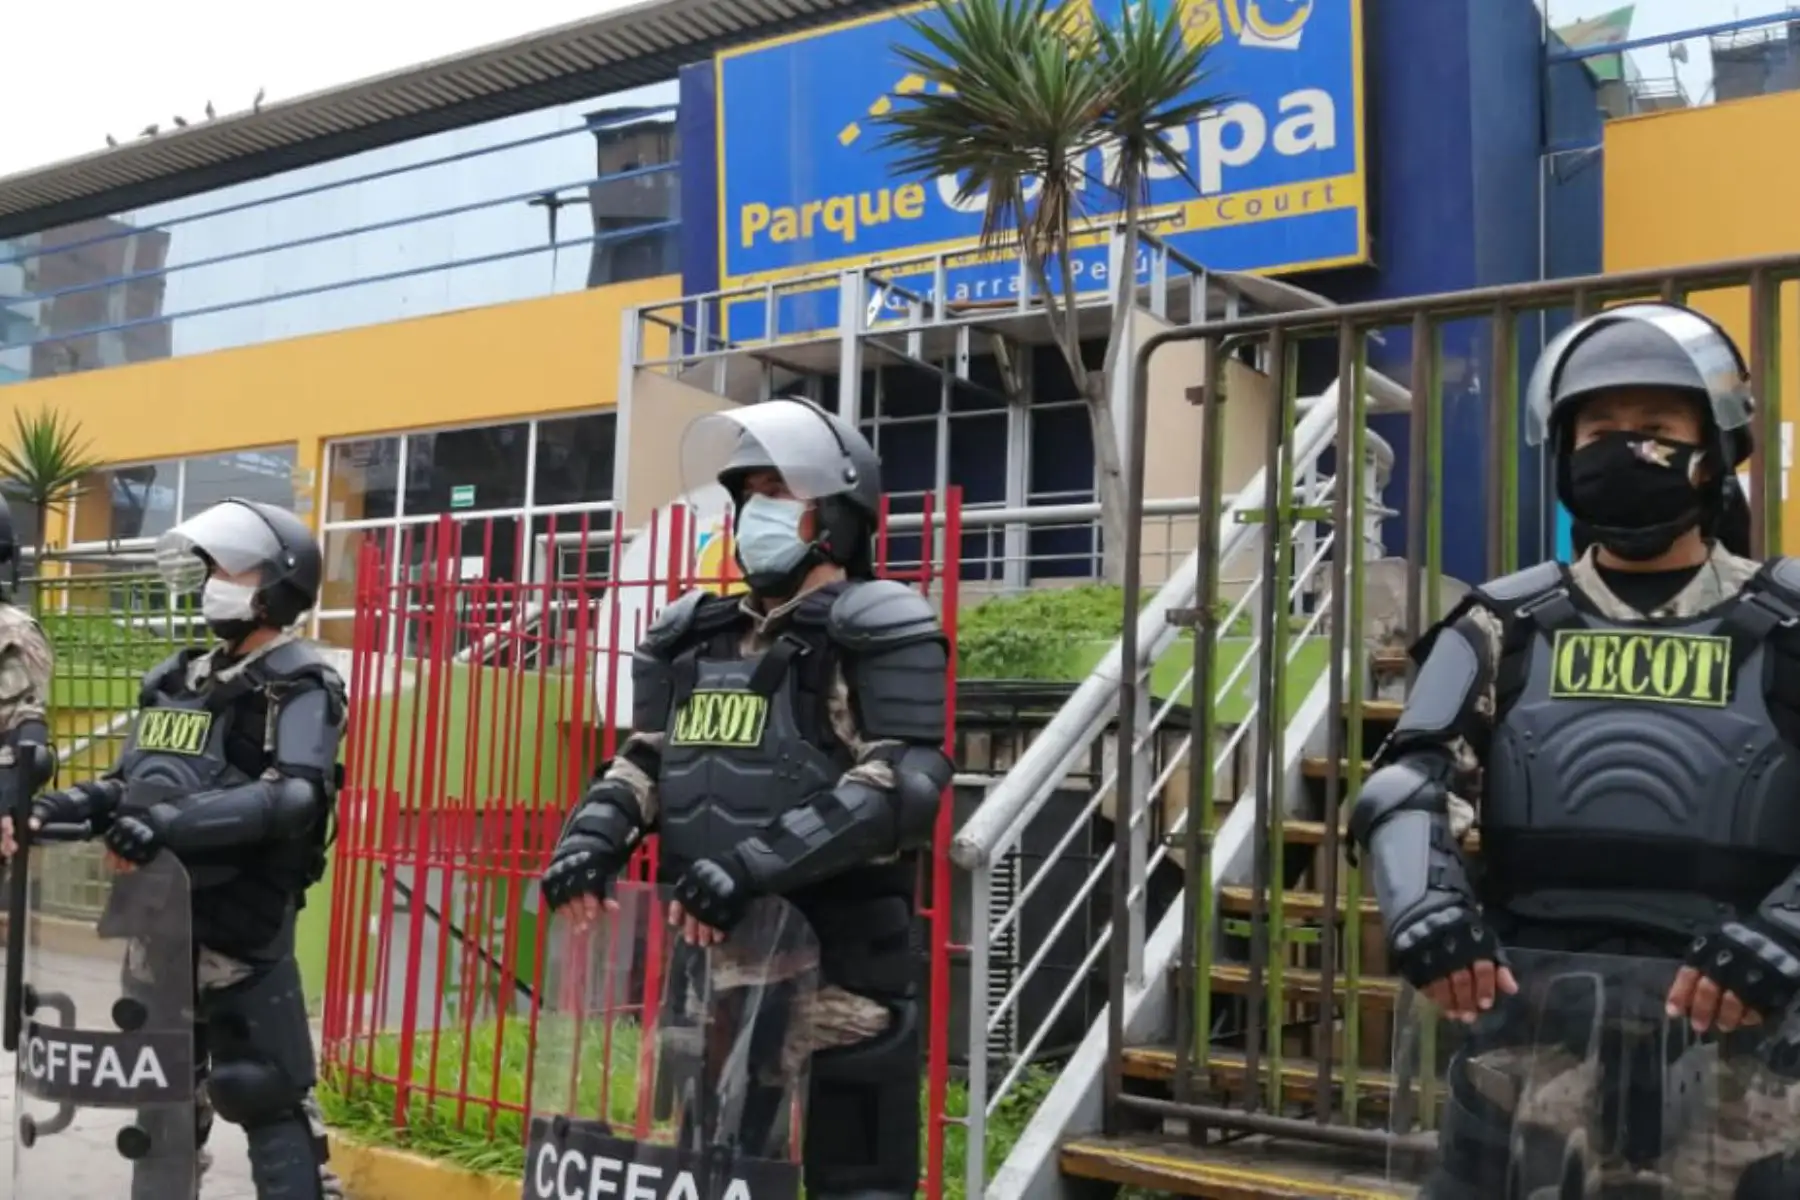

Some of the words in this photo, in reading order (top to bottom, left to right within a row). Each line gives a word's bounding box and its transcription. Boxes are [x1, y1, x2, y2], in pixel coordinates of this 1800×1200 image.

[741, 182, 926, 248] Parque
[937, 88, 1336, 212] nepa
[1216, 181, 1336, 220] Court
[884, 272, 1022, 309] Garra
[1070, 249, 1148, 281] Peú
[1559, 635, 1723, 698] CECOT
[139, 711, 208, 750] CECOT
[676, 693, 763, 741] CECOT
